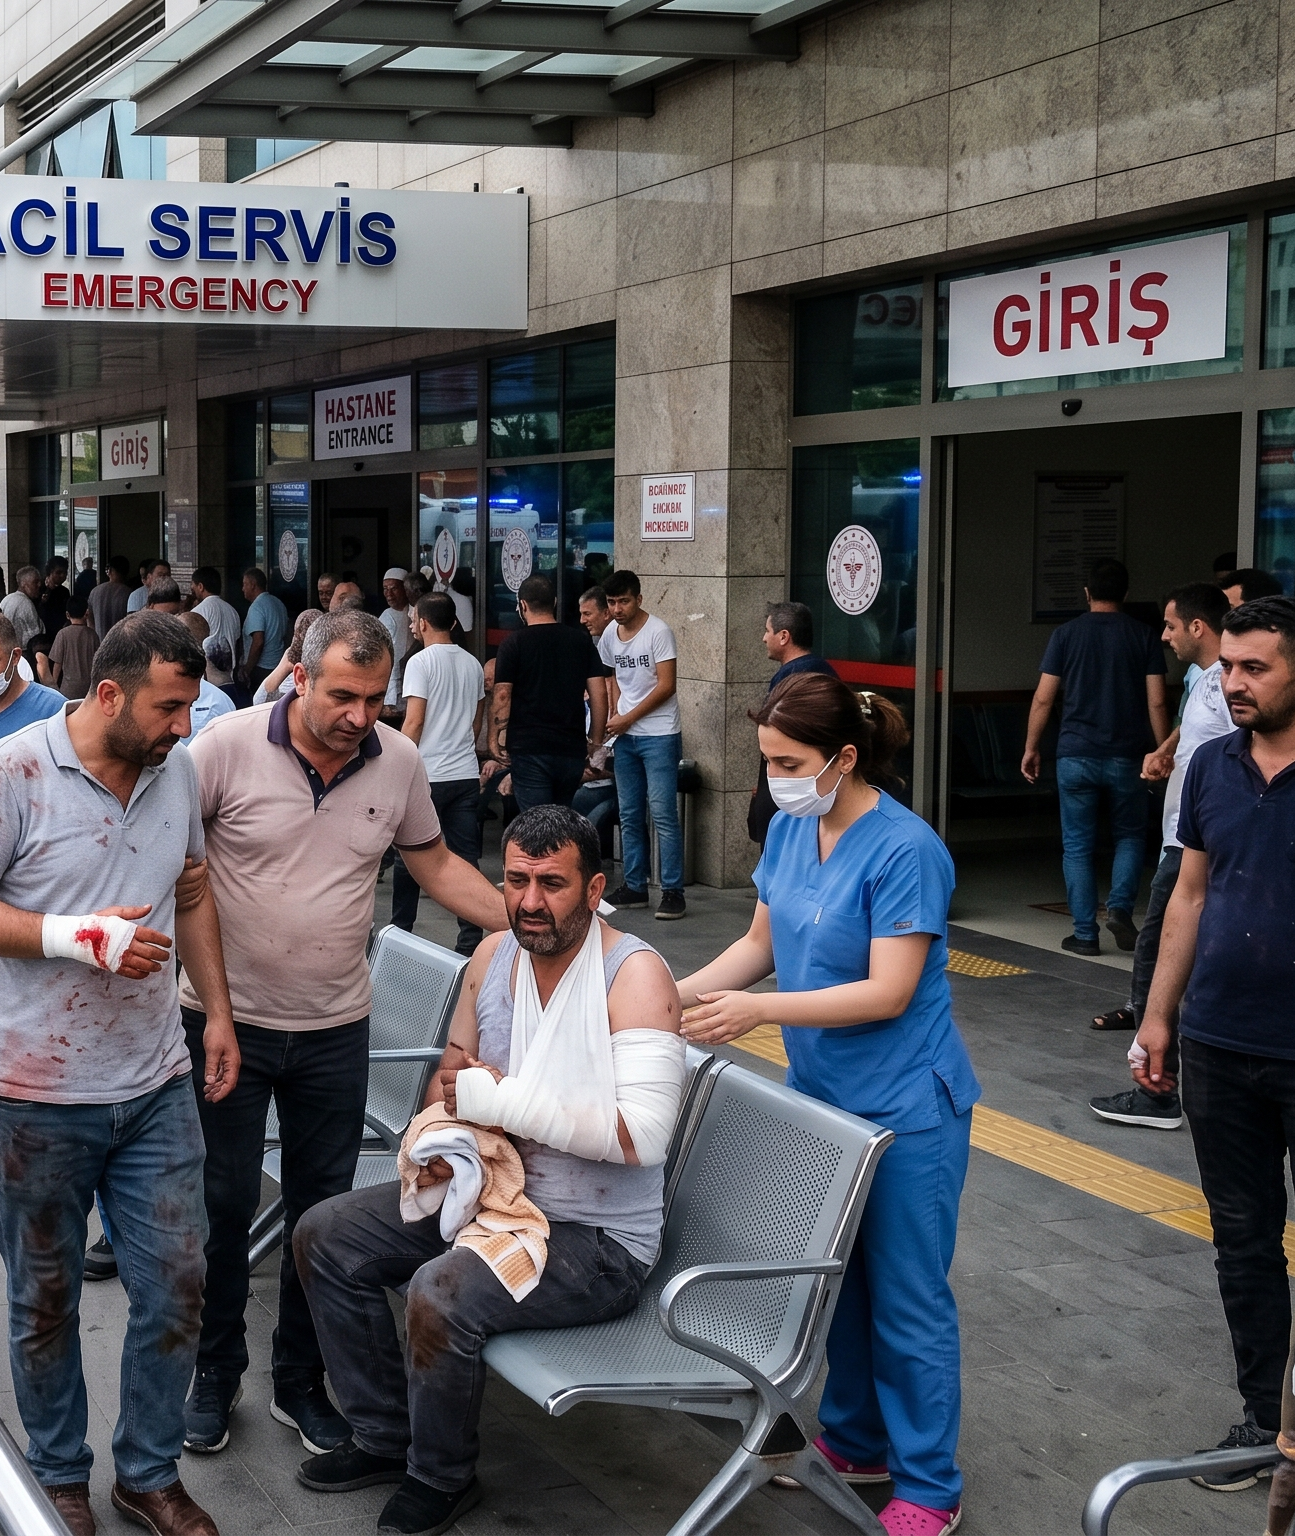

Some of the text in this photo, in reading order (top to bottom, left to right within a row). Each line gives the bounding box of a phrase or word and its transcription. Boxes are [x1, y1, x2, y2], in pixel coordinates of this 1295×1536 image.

[148, 197, 397, 265] SERVİS
[42, 272, 318, 313] EMERGENCY
[992, 260, 1170, 357] GİRİŞ
[325, 389, 396, 424] HASTANE
[111, 430, 149, 470] GİRİŞ
[328, 423, 394, 450] ENTRANCE
